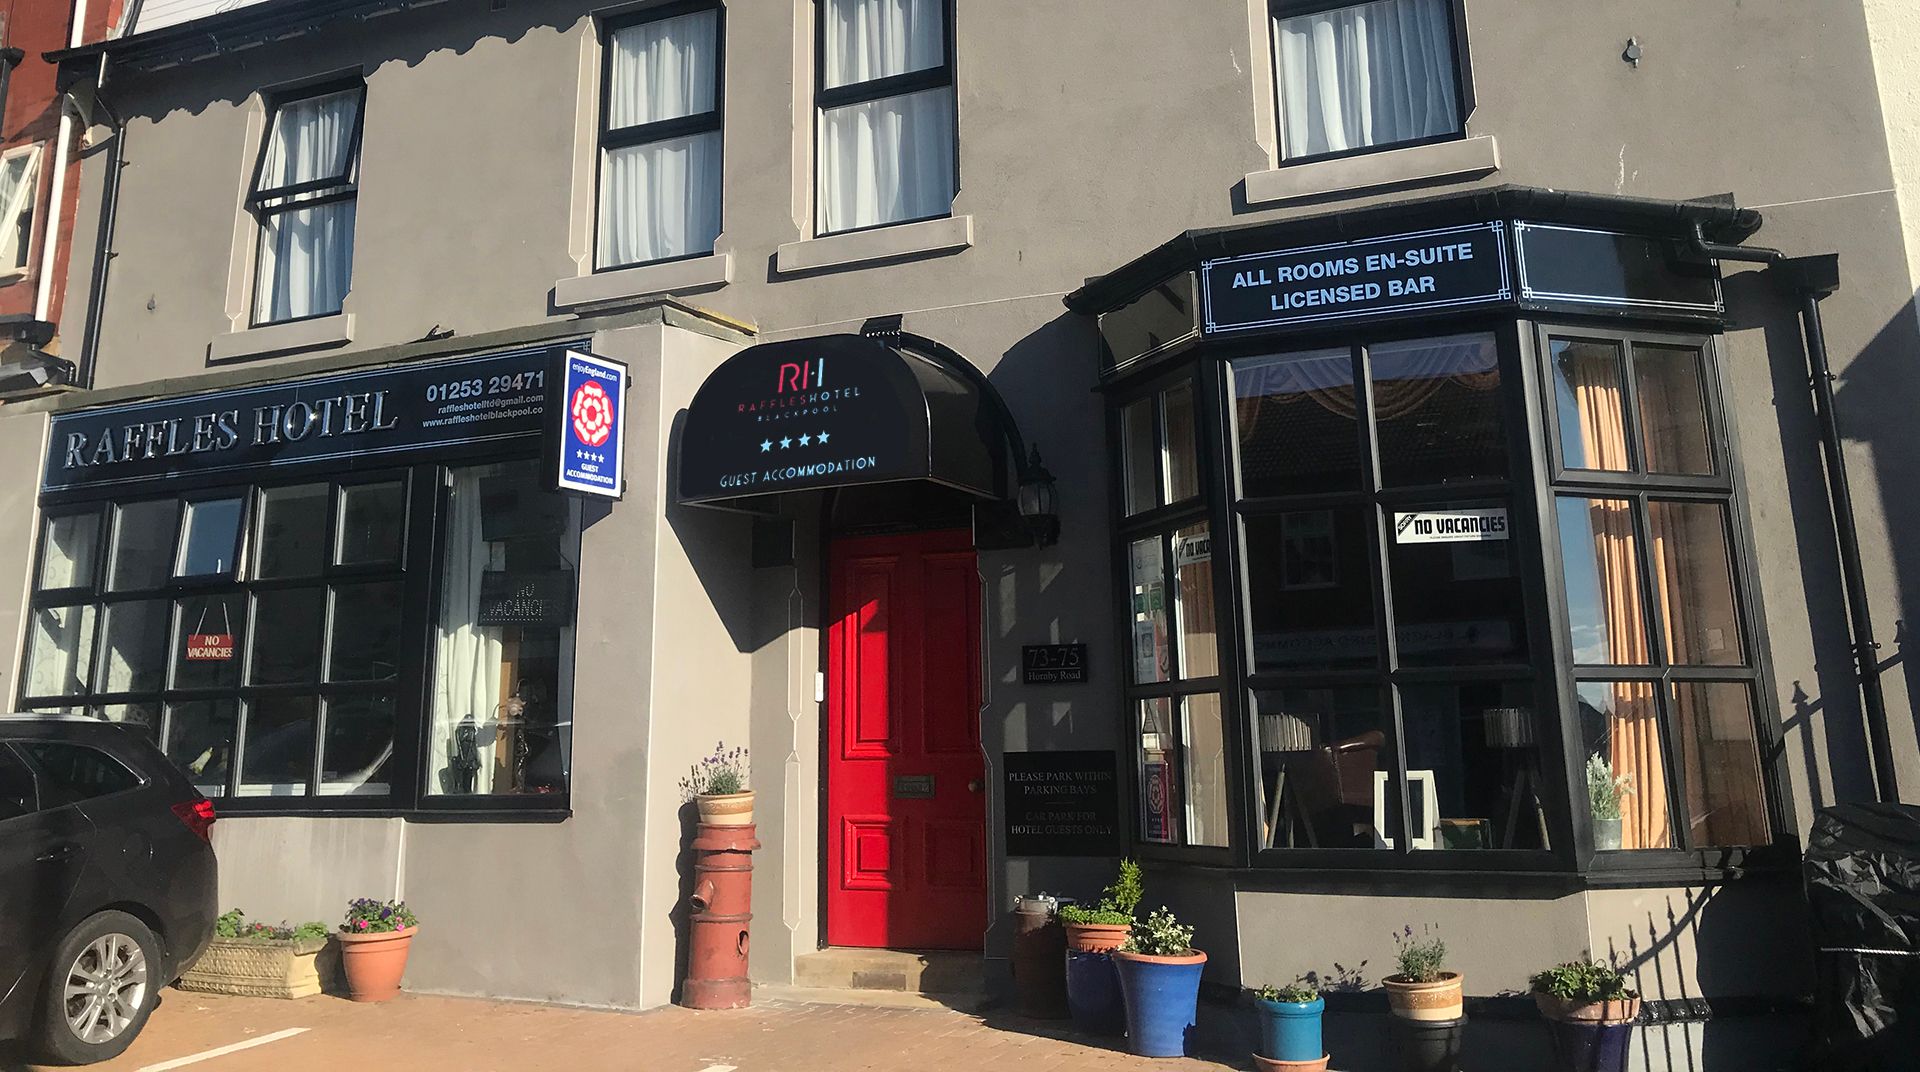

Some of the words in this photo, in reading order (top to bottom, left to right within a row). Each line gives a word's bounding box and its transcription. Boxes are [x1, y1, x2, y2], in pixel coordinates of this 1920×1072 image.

[1232, 269, 1272, 289] ALL
[1278, 257, 1359, 283] ROOMS
[1365, 243, 1474, 272] EN-SUITE
[1271, 282, 1381, 311] LICENSED
[1388, 275, 1436, 297] BAR
[426, 378, 484, 402] 01253
[757, 405, 838, 422] BLACKPOOL
[63, 410, 239, 469] RAFFLES
[250, 389, 399, 446] HOTEL
[581, 462, 599, 473] GUEST
[719, 471, 758, 488] GUEST
[763, 456, 877, 483] ACCOMMODATION
[566, 468, 614, 485] ACCOMMODATION
[1414, 519, 1433, 535] NO
[1436, 516, 1505, 534] VACANCIES
[204, 635, 220, 646] NO
[187, 647, 233, 658] VACANCIES
[1028, 647, 1079, 667] 73-75
[1028, 671, 1058, 682] Hornby
[1060, 670, 1081, 680] Road
[1009, 771, 1044, 781] PLEASE
[1046, 771, 1072, 781] PARK
[1074, 771, 1112, 781] WITHIN
[1024, 785, 1069, 795] PARKING
[1070, 785, 1097, 794] BAYS
[1011, 825, 1043, 834] HOTEL
[1045, 825, 1083, 834] GUESTS
[1085, 825, 1112, 834] ONLY
